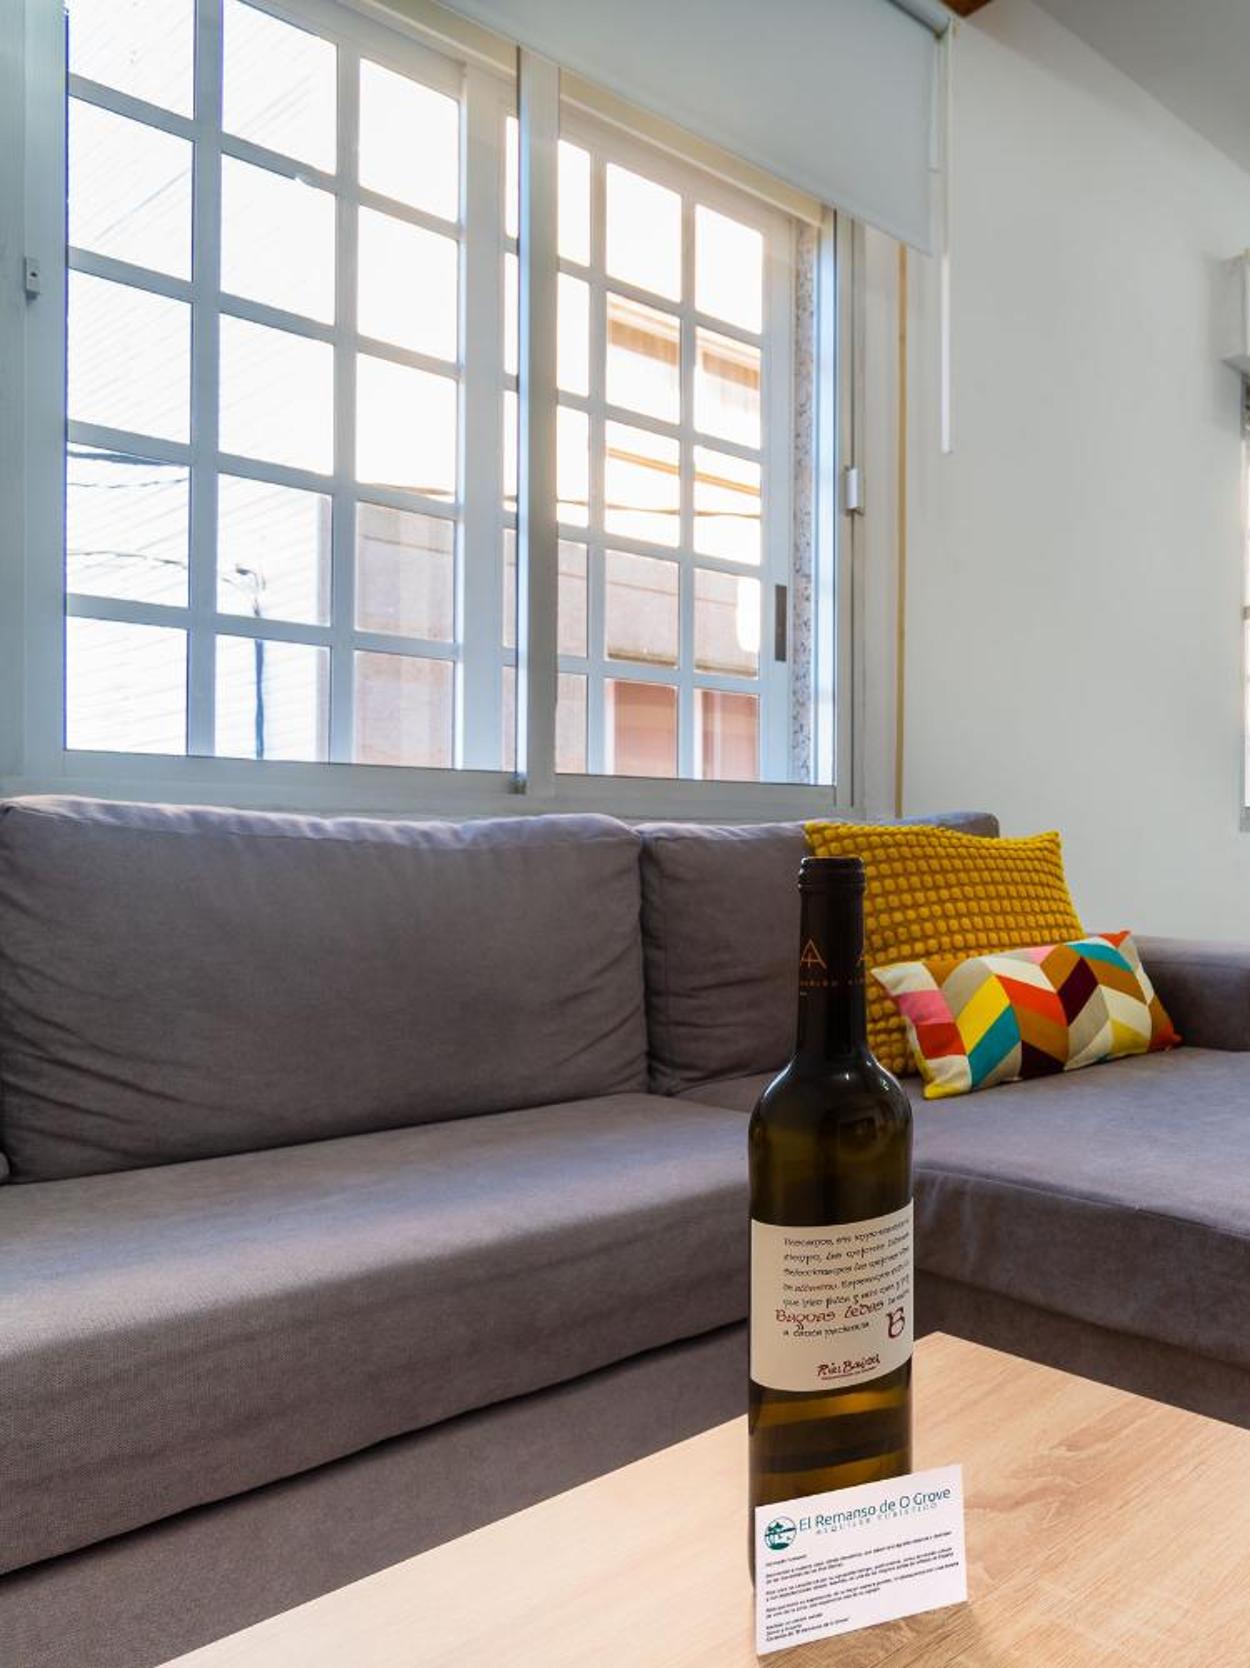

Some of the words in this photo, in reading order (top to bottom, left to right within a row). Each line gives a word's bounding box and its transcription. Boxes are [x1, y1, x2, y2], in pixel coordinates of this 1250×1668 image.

[799, 1516, 812, 1532] El
[816, 1504, 876, 1527] Remanso
[878, 1498, 896, 1514] de
[899, 1495, 911, 1509] O
[913, 1487, 951, 1507] Grove
